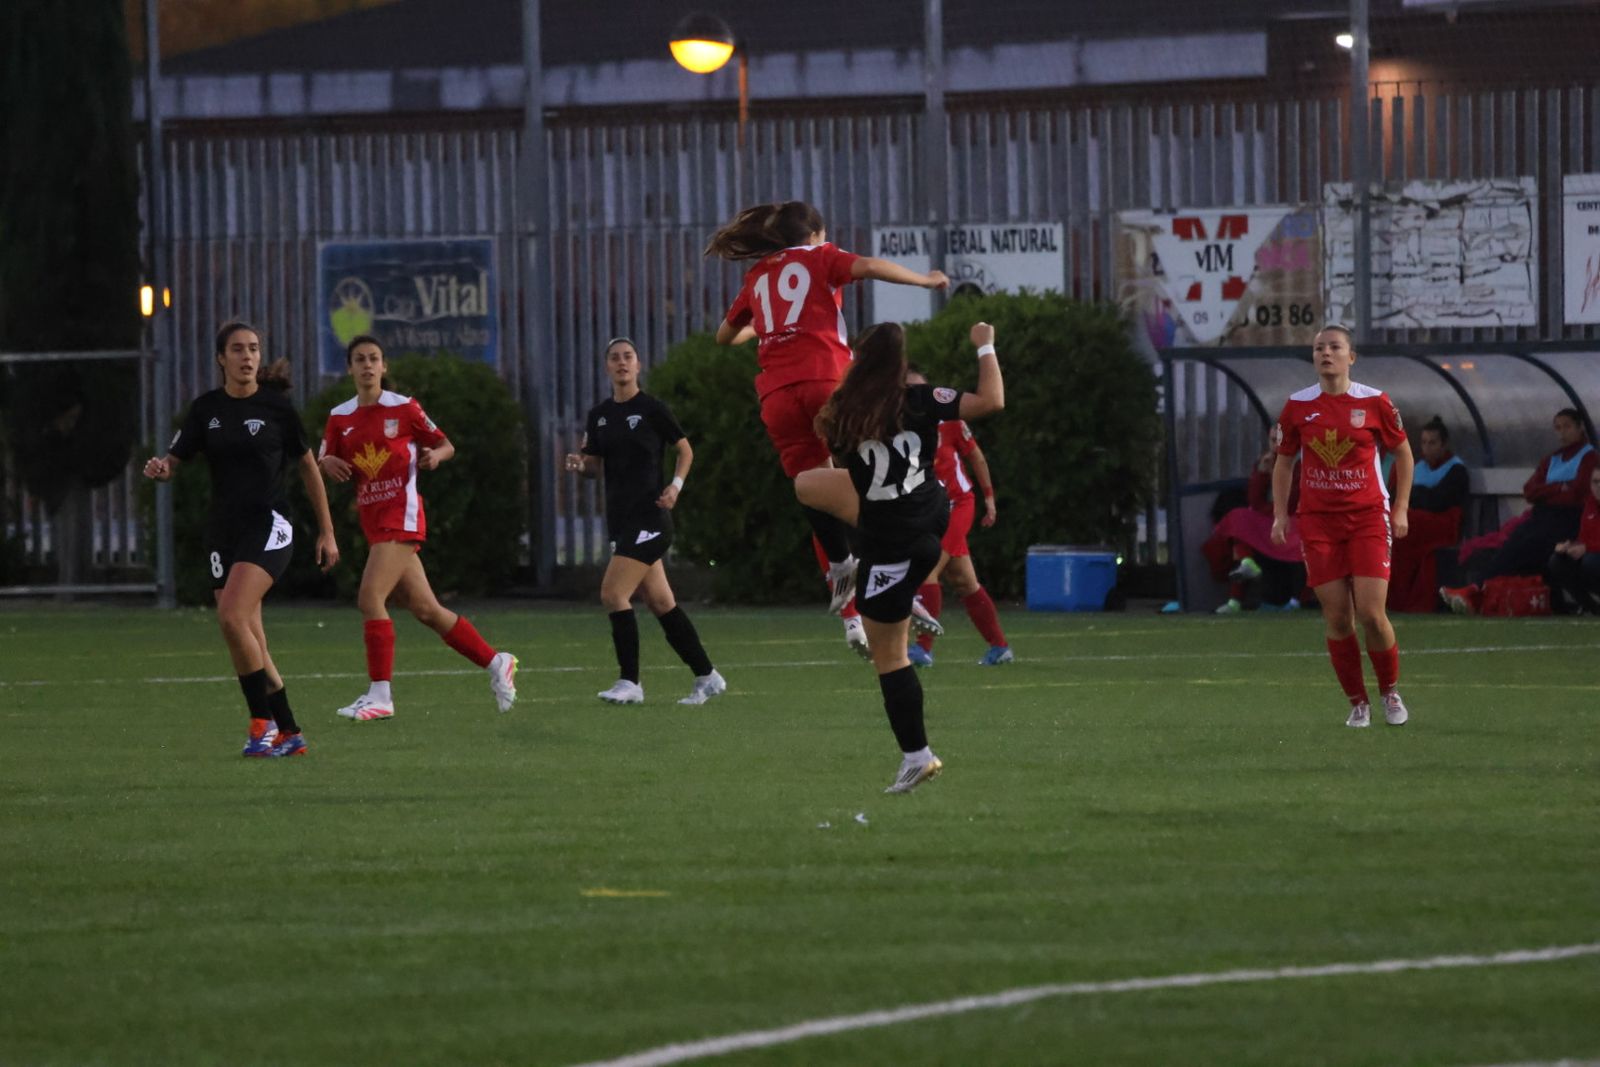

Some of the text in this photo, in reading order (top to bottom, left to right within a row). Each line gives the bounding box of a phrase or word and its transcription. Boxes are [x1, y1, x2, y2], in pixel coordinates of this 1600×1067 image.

[880, 227, 1057, 257] AGUA MERAL NATURAL
[414, 269, 489, 318] Vital
[753, 261, 811, 334] 19
[1256, 304, 1282, 327] 03
[1289, 303, 1315, 326] 86
[857, 429, 926, 502] 22
[210, 551, 224, 579] 8
